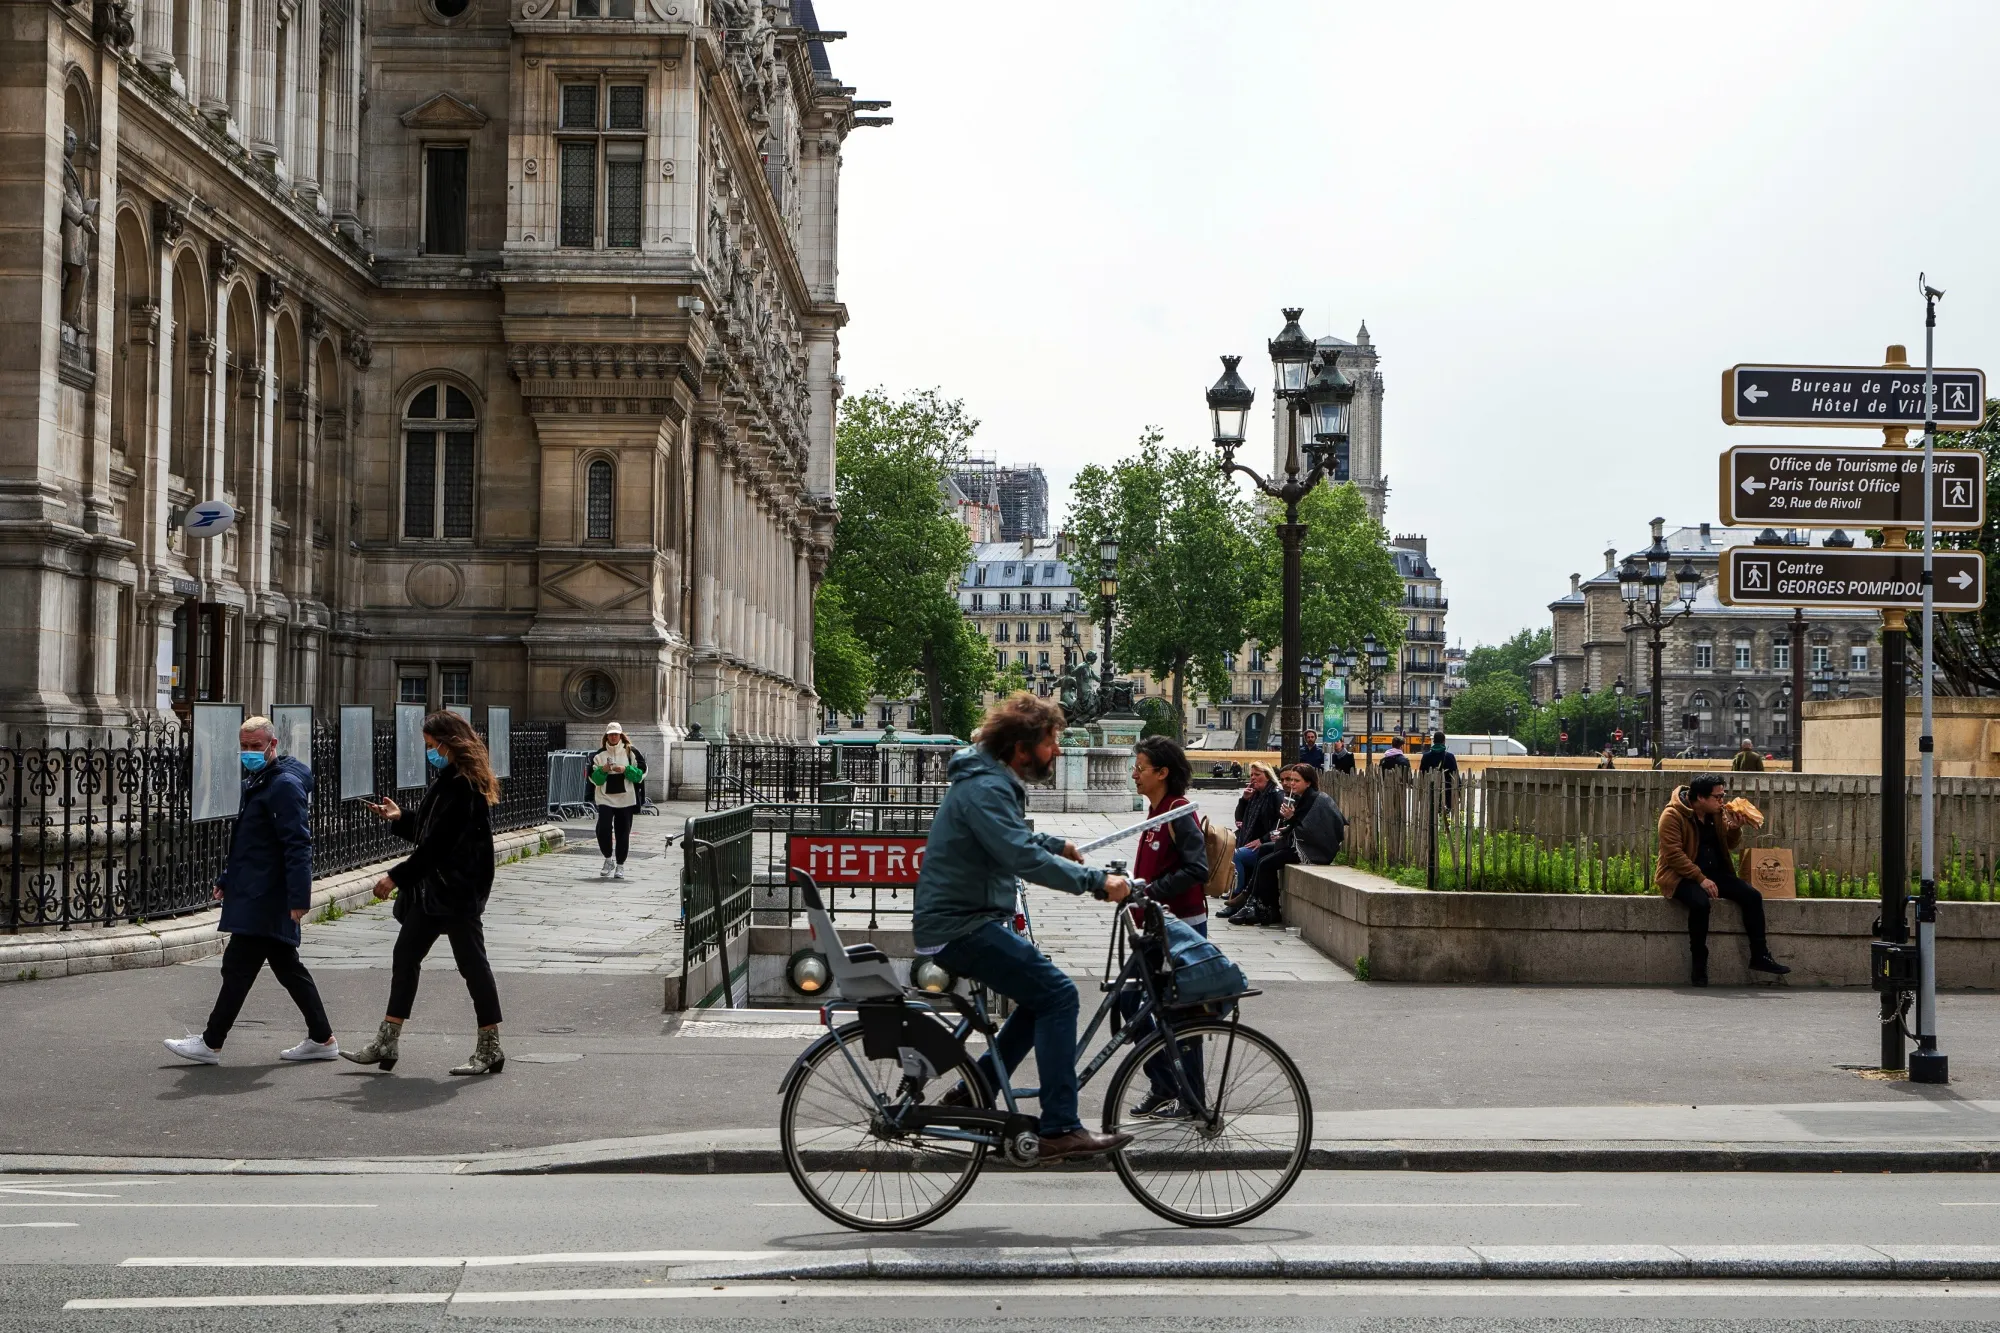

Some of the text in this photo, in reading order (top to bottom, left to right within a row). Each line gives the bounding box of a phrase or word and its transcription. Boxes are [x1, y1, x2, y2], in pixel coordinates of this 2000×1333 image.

[1791, 378, 1938, 395] Bureau de Poste
[1812, 398, 1938, 414] Hôtel de Ville
[1769, 457, 1812, 472] Office
[1815, 458, 1832, 472] de
[1836, 458, 1898, 473] Tourisme
[1901, 459, 1918, 473] de
[1769, 477, 1900, 493] Paris Tourist Office
[1769, 497, 1862, 509] 29, Rue de Rivoli
[1777, 560, 1824, 575] Centre
[181, 581, 199, 593] POSTE
[1777, 579, 1925, 596] GEORGES POMPIDOU
